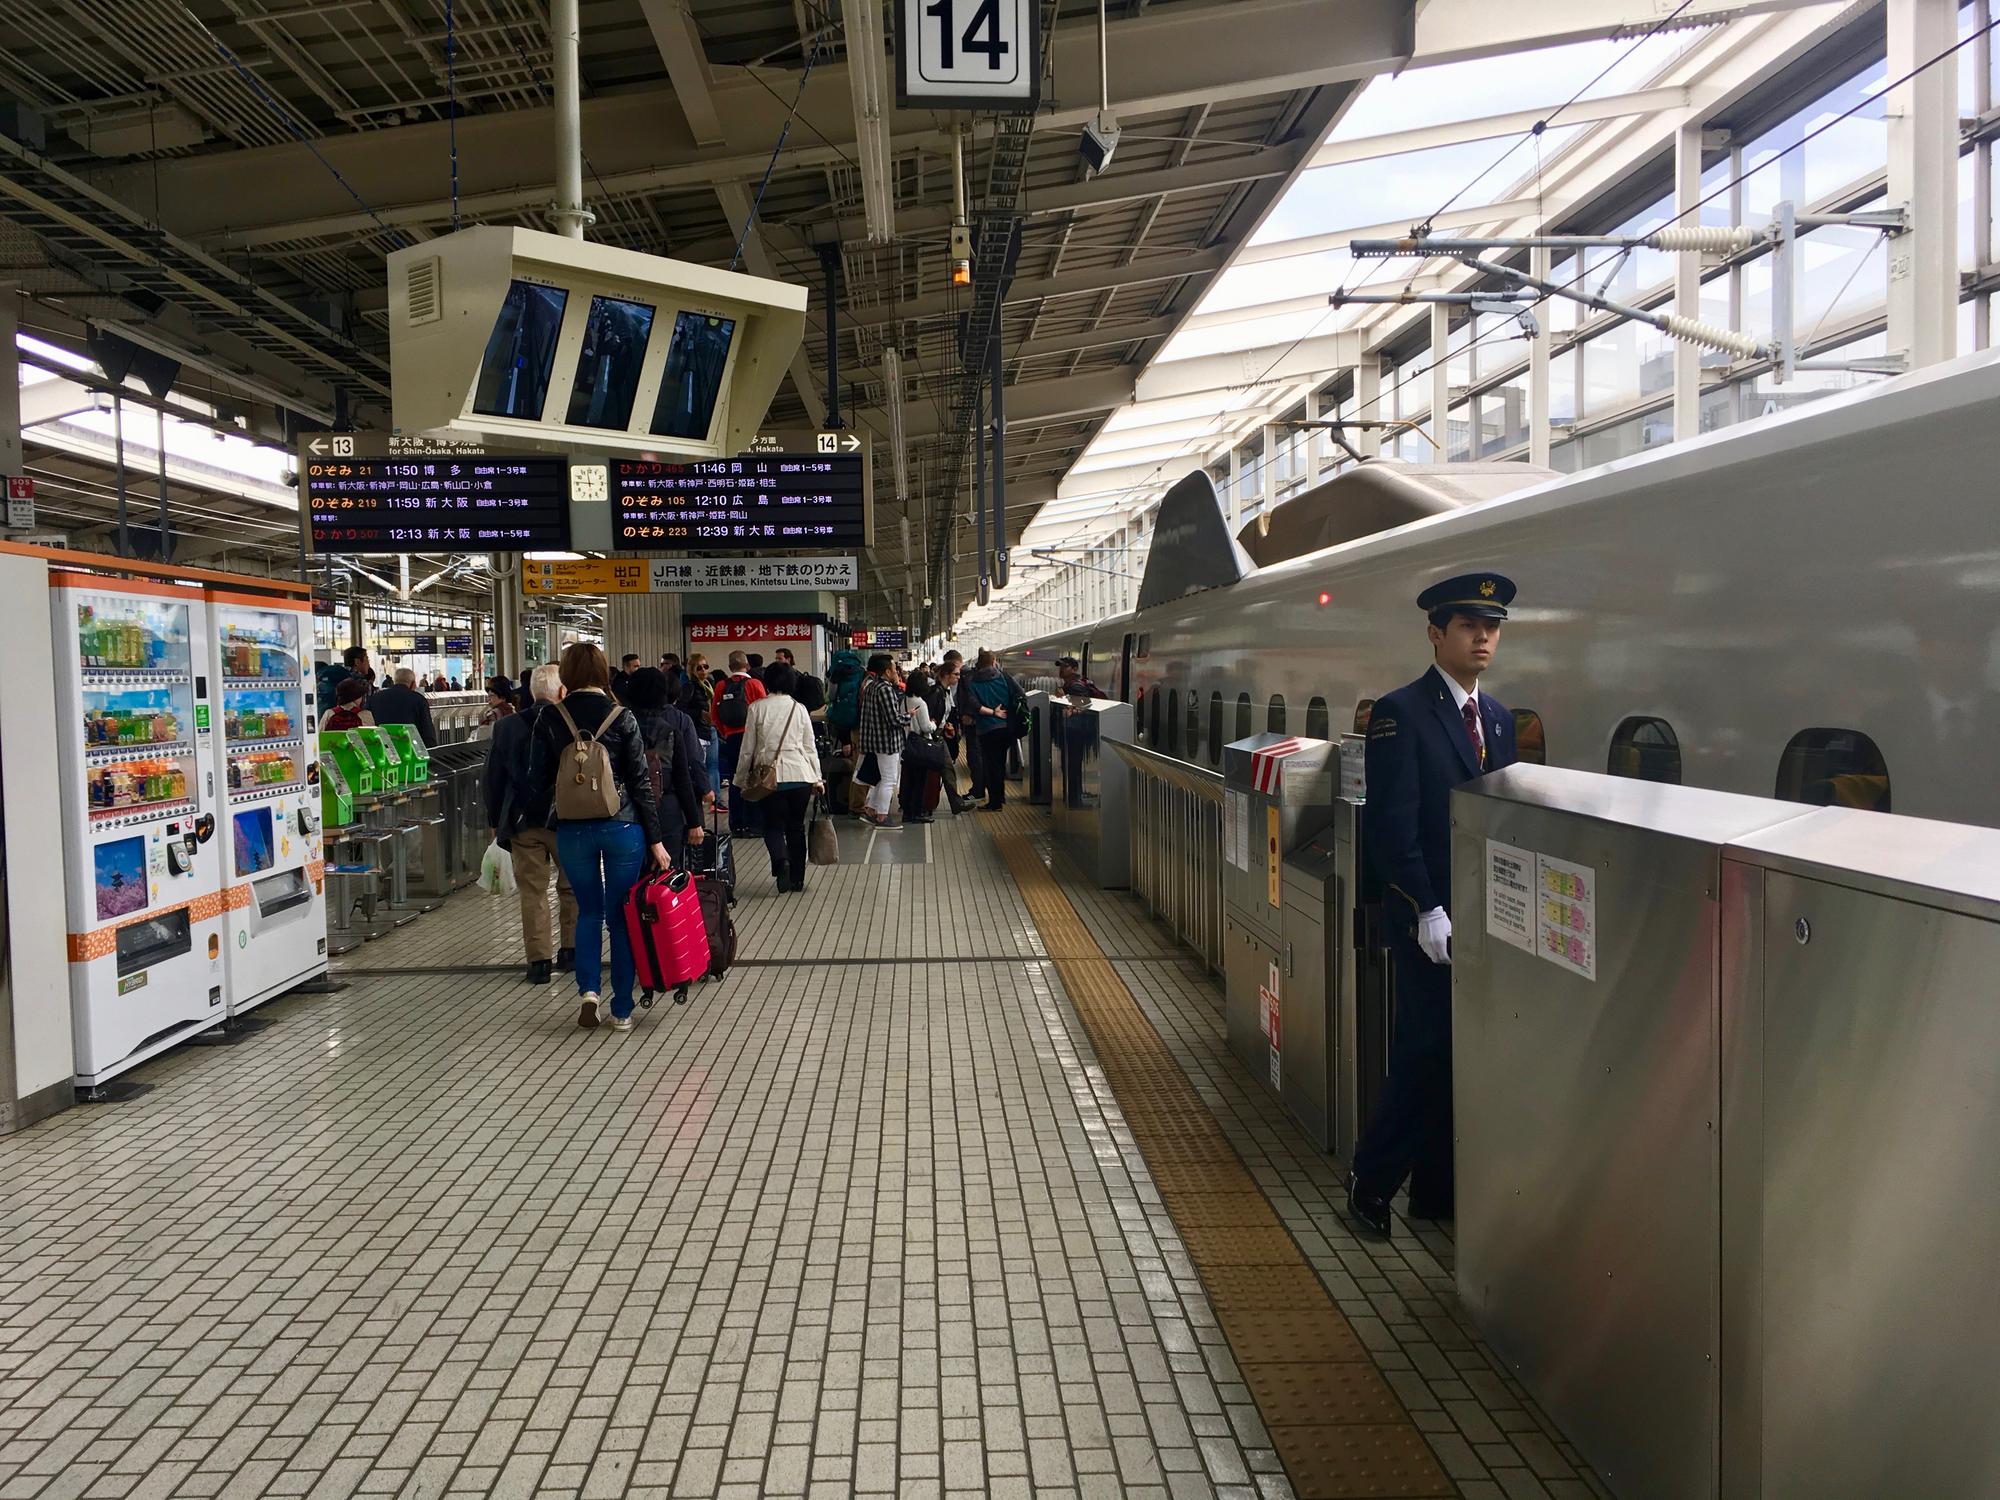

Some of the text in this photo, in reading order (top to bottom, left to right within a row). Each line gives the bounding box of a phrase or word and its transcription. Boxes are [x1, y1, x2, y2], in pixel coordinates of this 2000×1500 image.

[926, 0, 1009, 70] 14
[334, 439, 351, 454] 13
[755, 445, 784, 453] Hakata
[819, 436, 835, 451] 14
[389, 446, 485, 456] for Shin-Ōsaka, Hakata
[309, 465, 352, 476] のぞみ
[360, 466, 372, 475] 21
[385, 465, 418, 476] 11:50
[620, 463, 663, 474] ひかり
[693, 463, 726, 474] 11:46
[311, 498, 354, 509] のぞみ
[358, 499, 377, 508] 219
[387, 498, 420, 509] 11:59
[425, 497, 469, 508] 新大阪
[621, 496, 663, 507] のぞみ
[667, 497, 686, 505] 105
[695, 495, 727, 506] 12:10
[313, 529, 357, 540] ひかり
[389, 528, 423, 539] 12:13
[427, 528, 471, 539] 新大阪
[623, 526, 665, 538] のぞみ
[668, 527, 688, 536] 223
[696, 526, 729, 537] 12:39
[733, 525, 775, 536] 新大阪
[1000, 552, 1006, 561] 5
[614, 566, 640, 578] 出口
[620, 579, 637, 588] Exit
[654, 576, 850, 588] Transfer to JR Lines, Kintetsu Line, Subway
[981, 578, 987, 586] 6
[691, 624, 811, 637] お弁当 サンド お飲物
